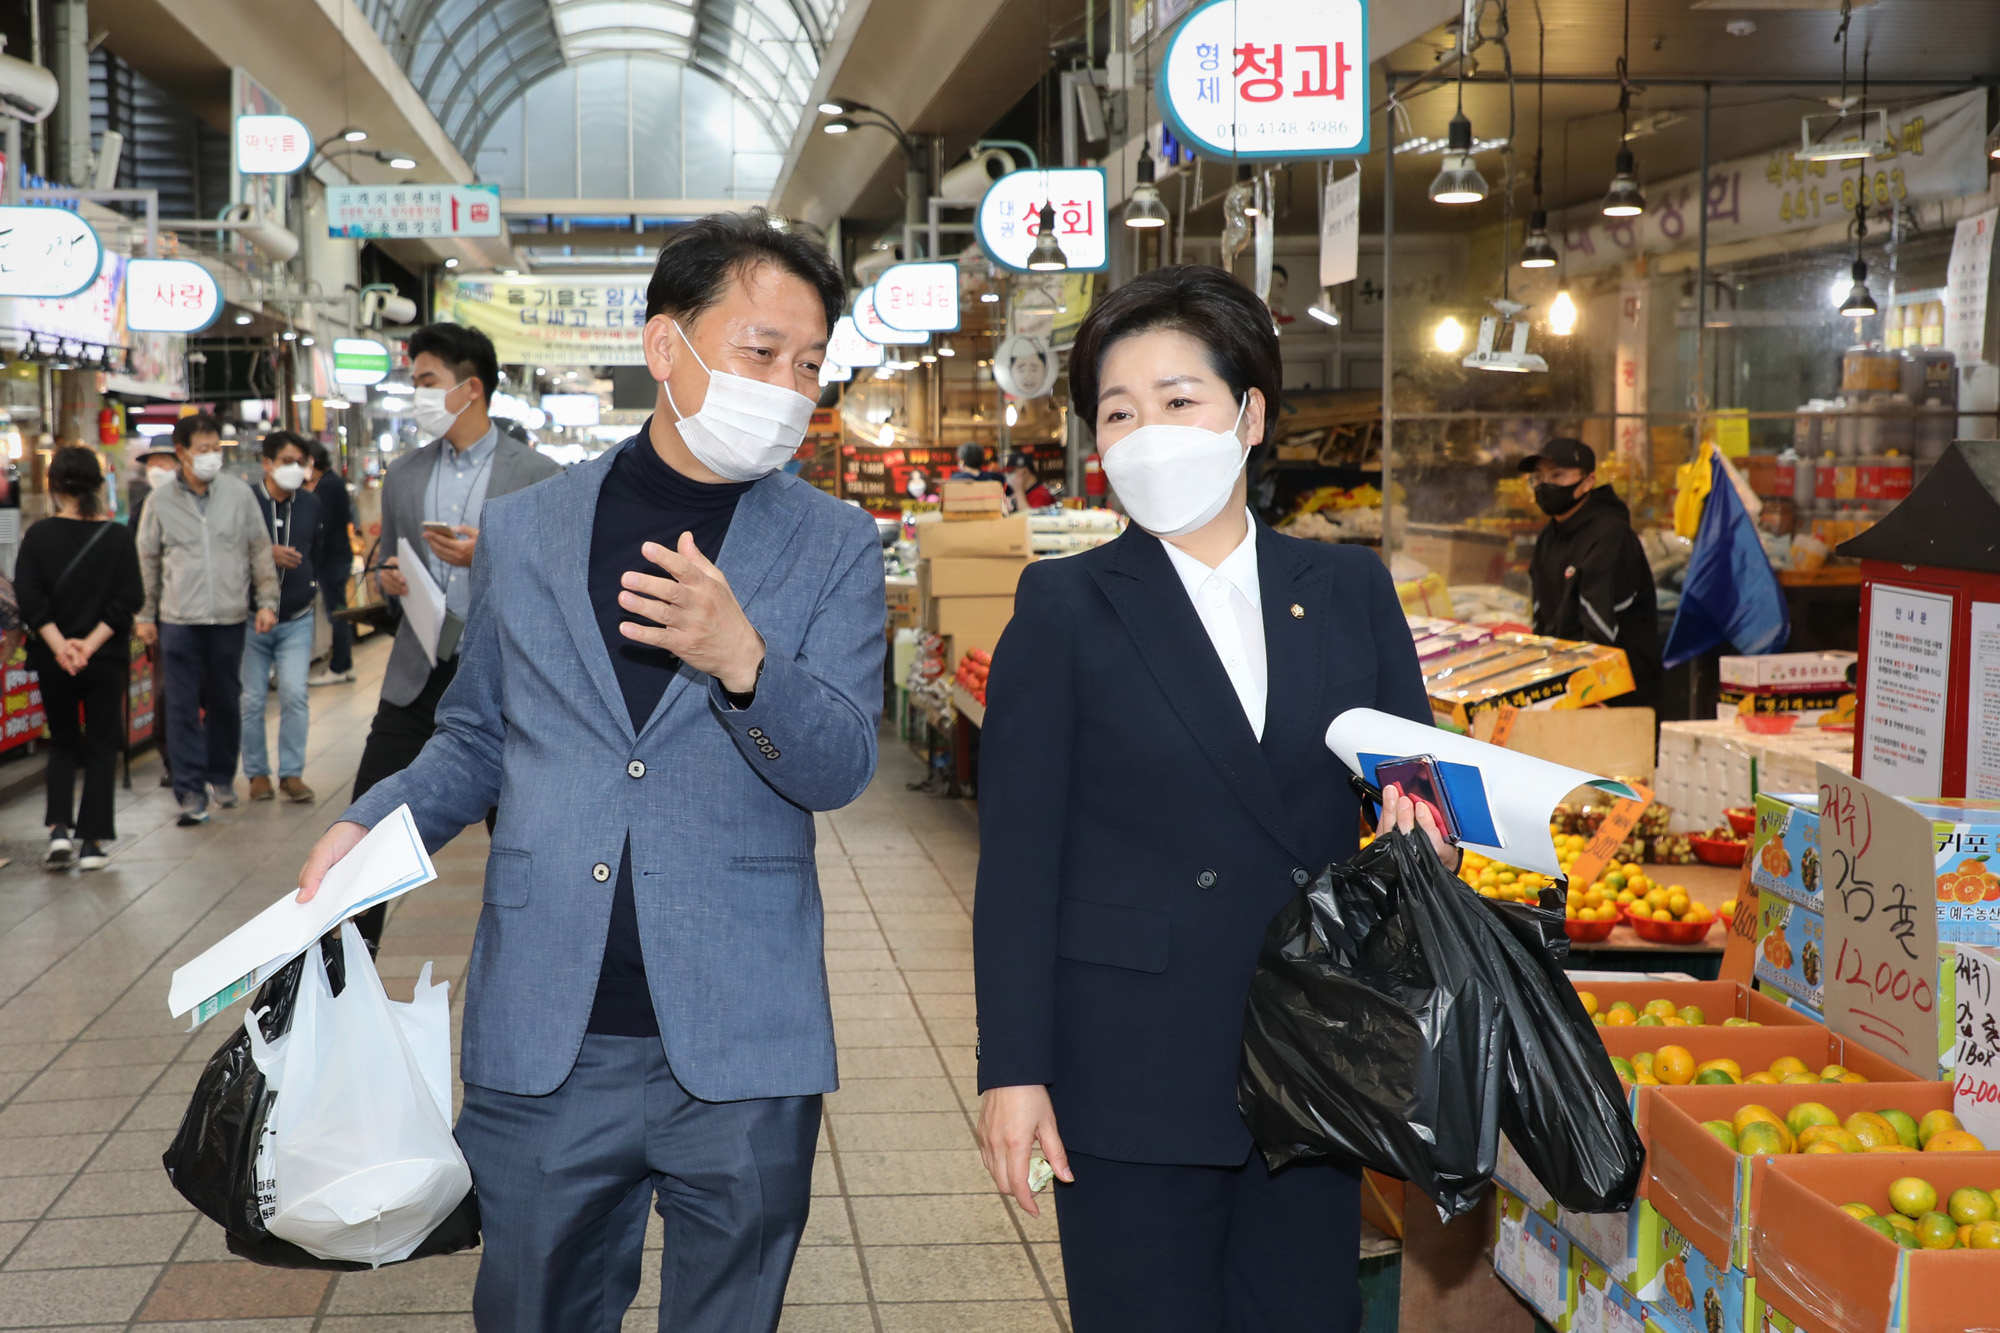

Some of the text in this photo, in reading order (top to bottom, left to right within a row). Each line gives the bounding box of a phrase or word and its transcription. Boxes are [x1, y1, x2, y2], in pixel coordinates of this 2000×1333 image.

[1196, 43, 1220, 104] 형제
[1232, 41, 1352, 103] 청과
[1217, 120, 1348, 138] 010 4148 4986
[1022, 200, 1093, 238] 상회
[154, 284, 204, 309] 사랑
[1894, 607, 1927, 625] 안내문
[1834, 937, 1933, 1013] 12,000
[1953, 1072, 2000, 1107] 12,00
